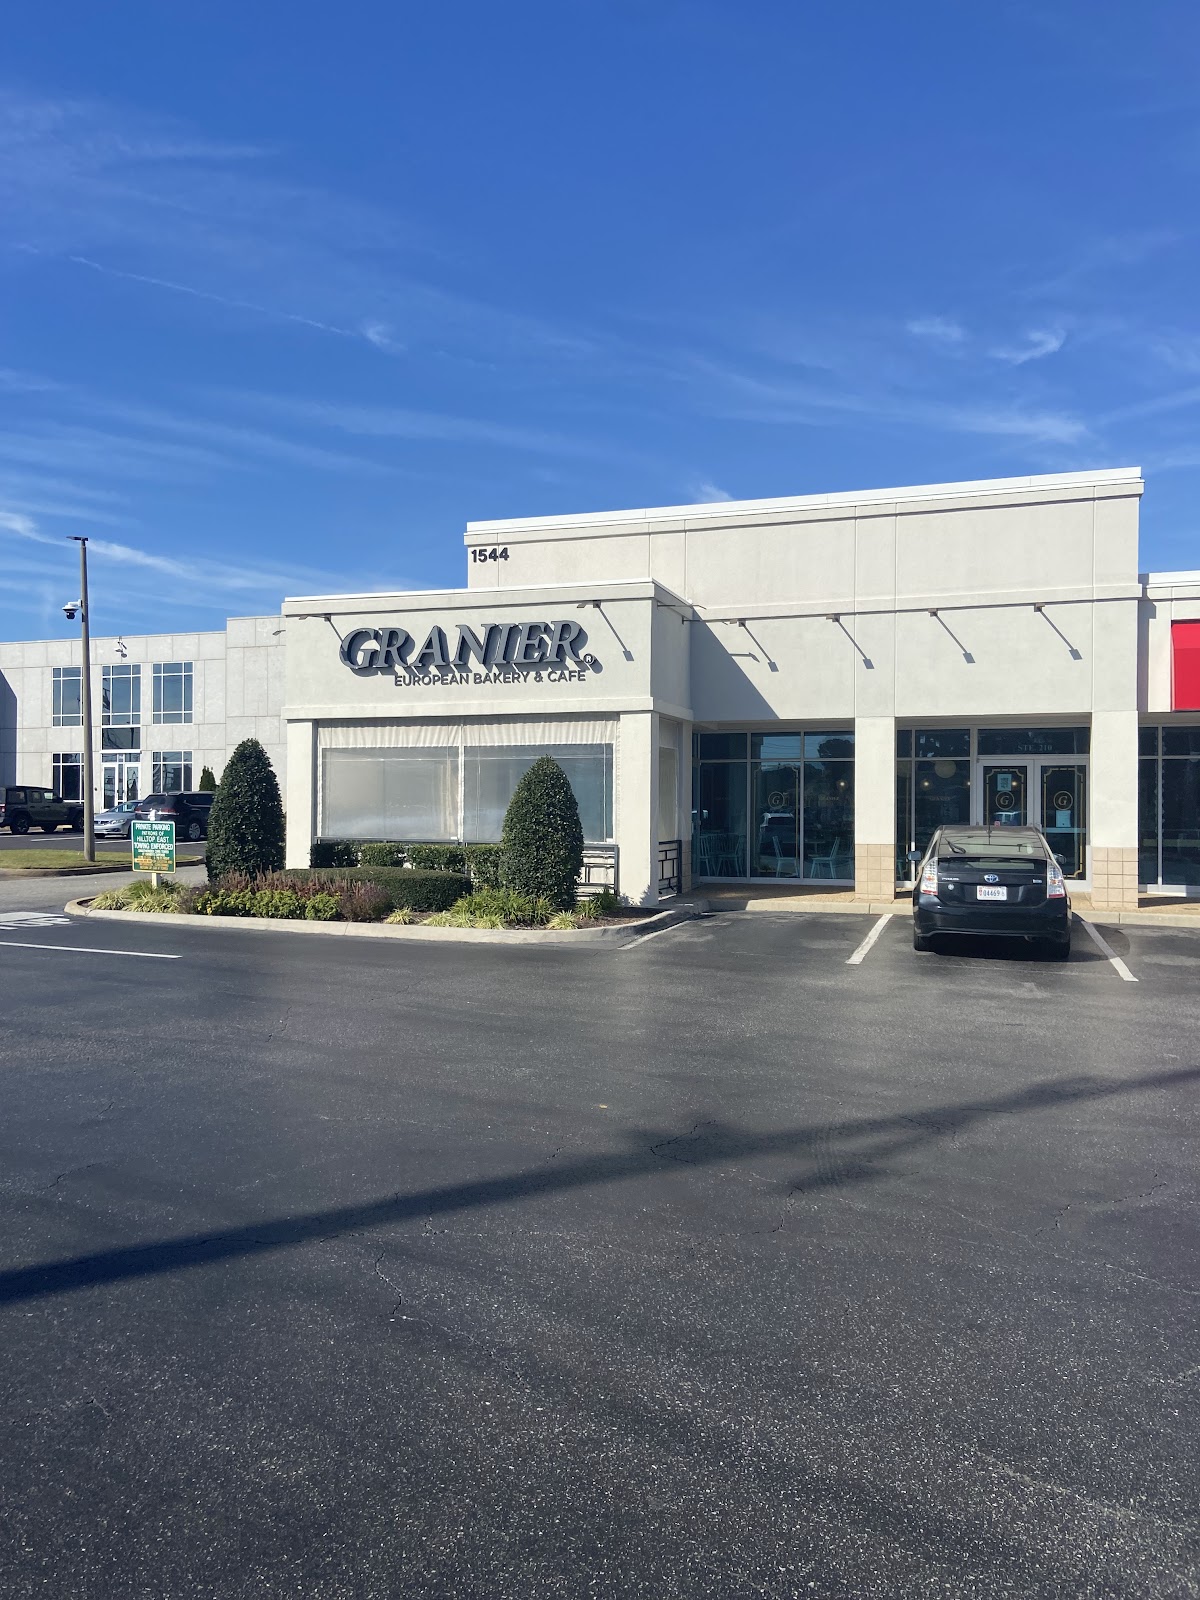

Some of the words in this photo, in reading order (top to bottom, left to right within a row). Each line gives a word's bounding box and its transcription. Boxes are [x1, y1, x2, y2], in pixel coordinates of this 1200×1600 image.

[471, 547, 509, 563] 1544
[339, 620, 587, 672] GRANIER
[394, 673, 470, 687] EUROPEAN
[473, 671, 530, 685] BAKERY
[533, 671, 544, 683] &
[547, 669, 586, 683] CAFE
[1000, 795, 1009, 805] G
[1058, 795, 1068, 805] G
